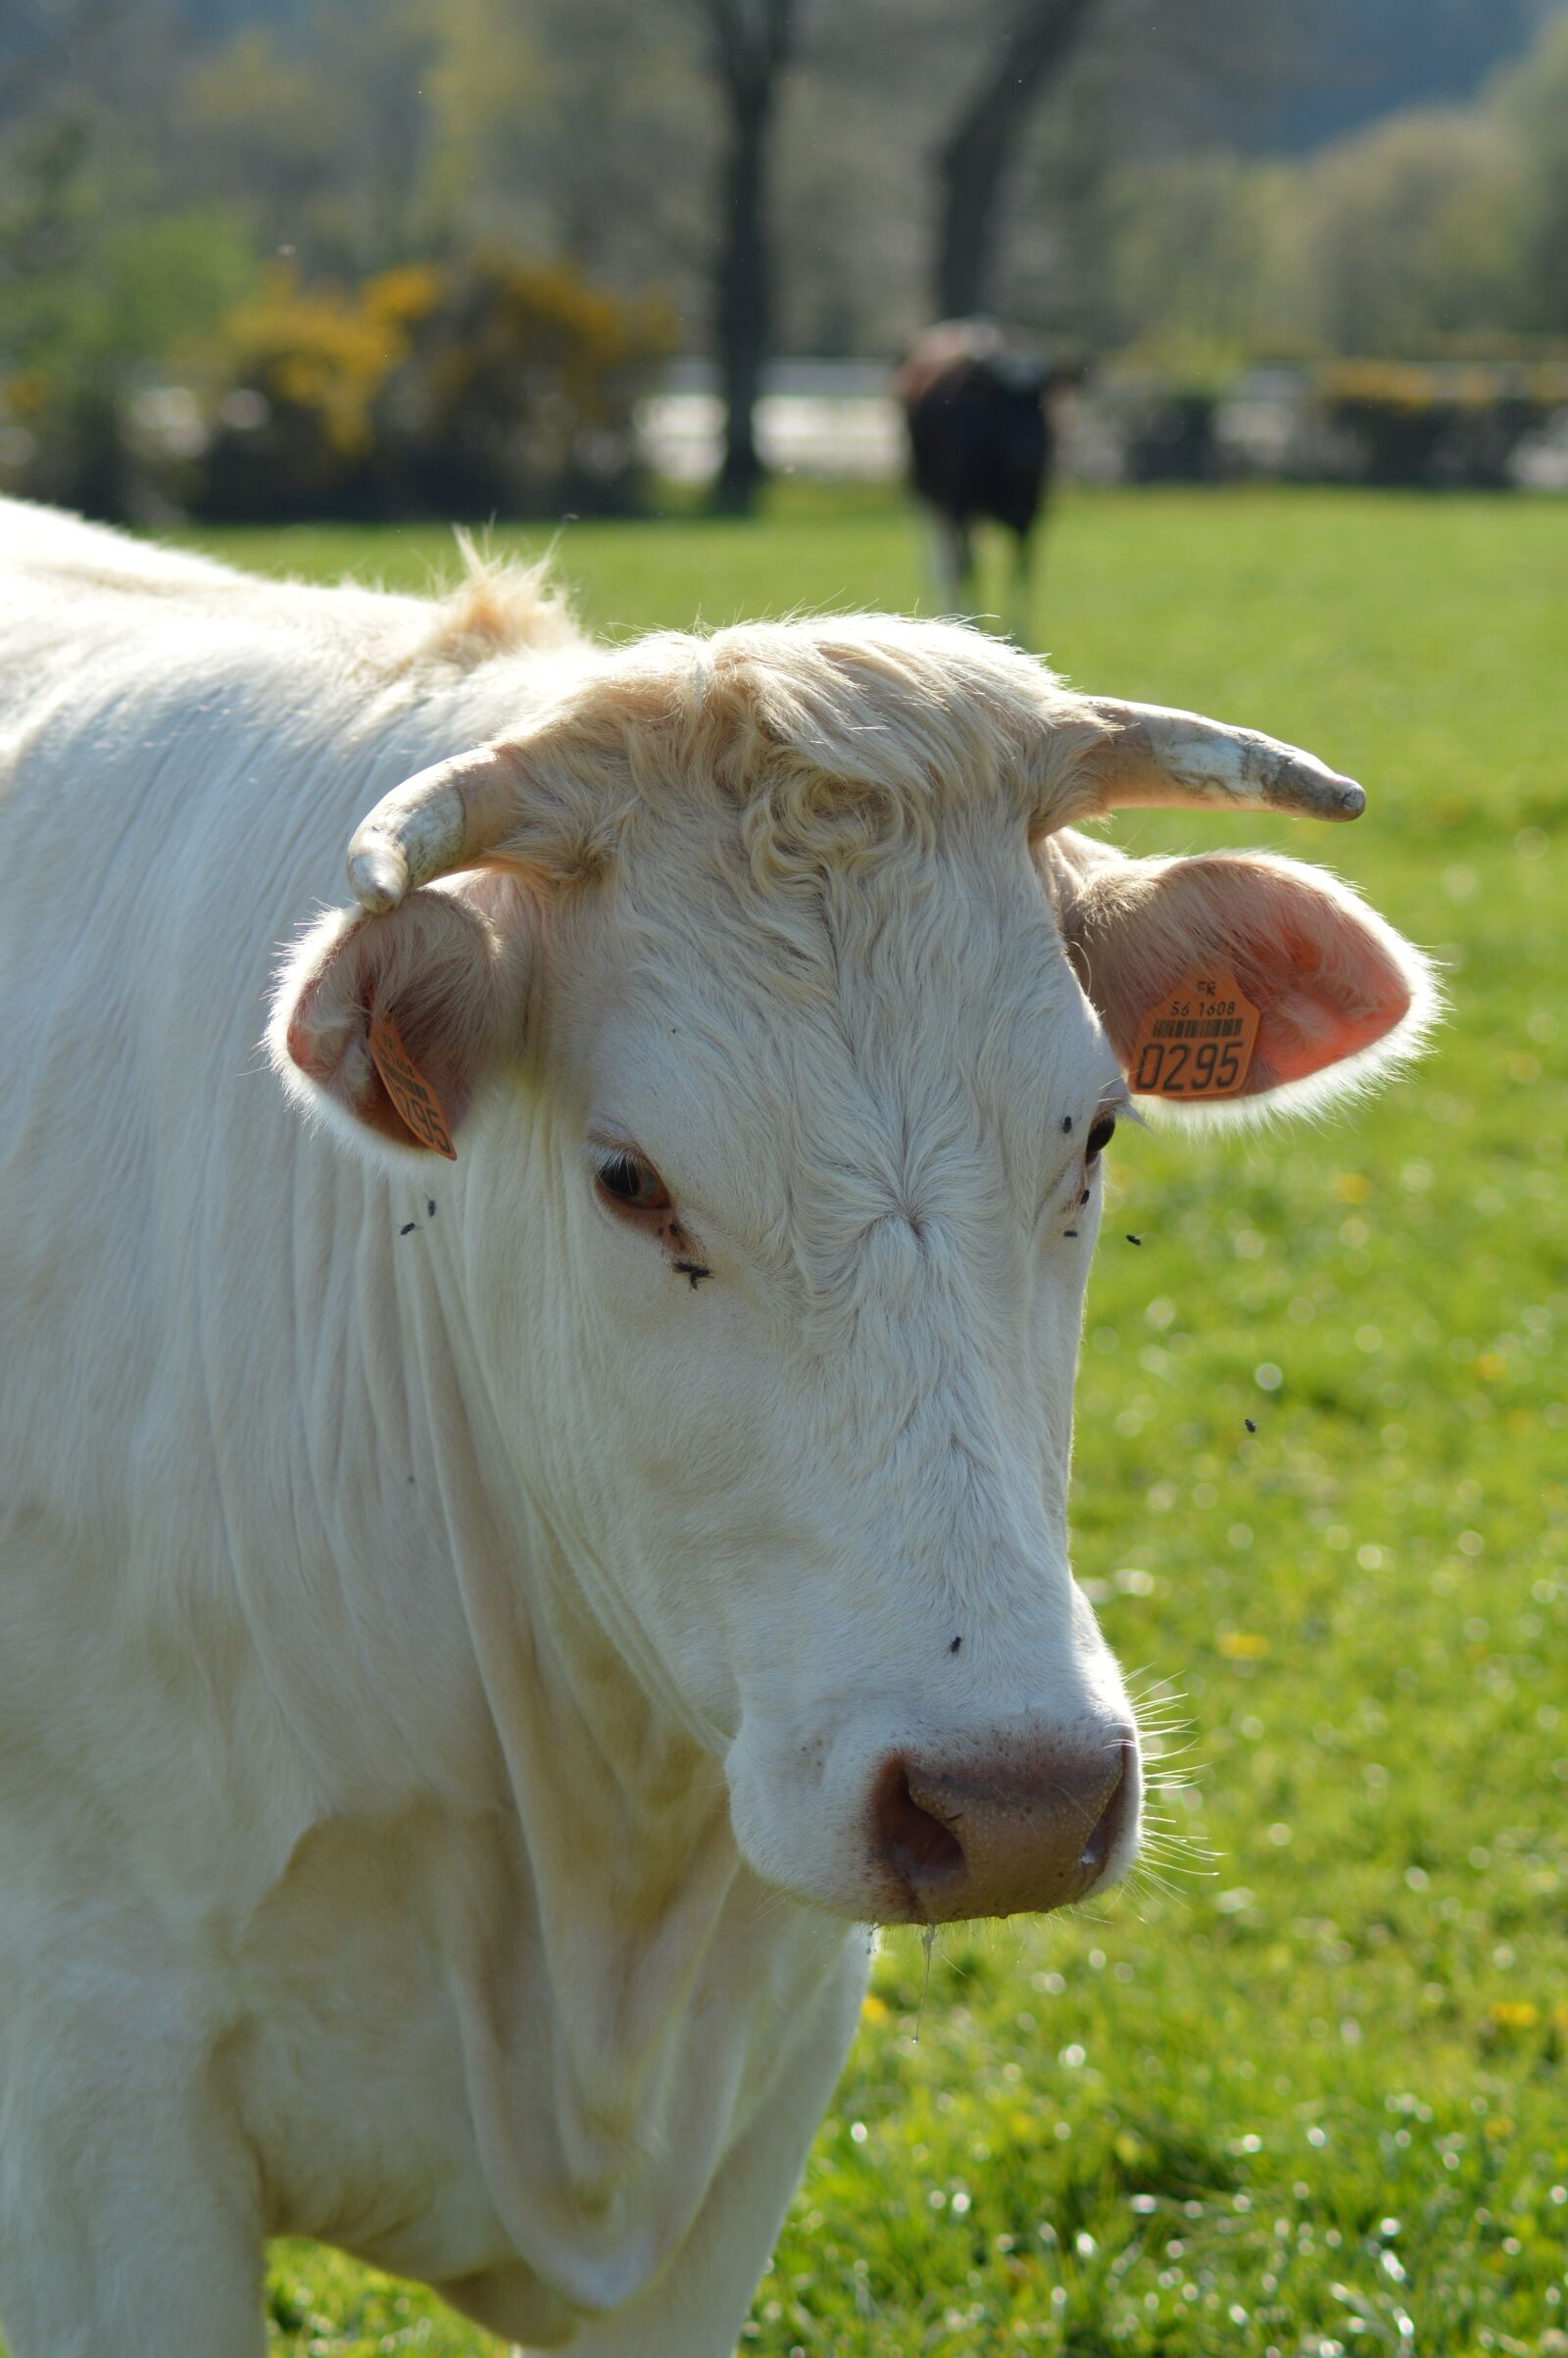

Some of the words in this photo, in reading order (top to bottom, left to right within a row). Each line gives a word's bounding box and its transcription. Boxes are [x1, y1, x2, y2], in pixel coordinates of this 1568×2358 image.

[1171, 1001, 1192, 1016] 56
[1199, 1001, 1237, 1016] 1608
[1136, 1041, 1245, 1091] 0295
